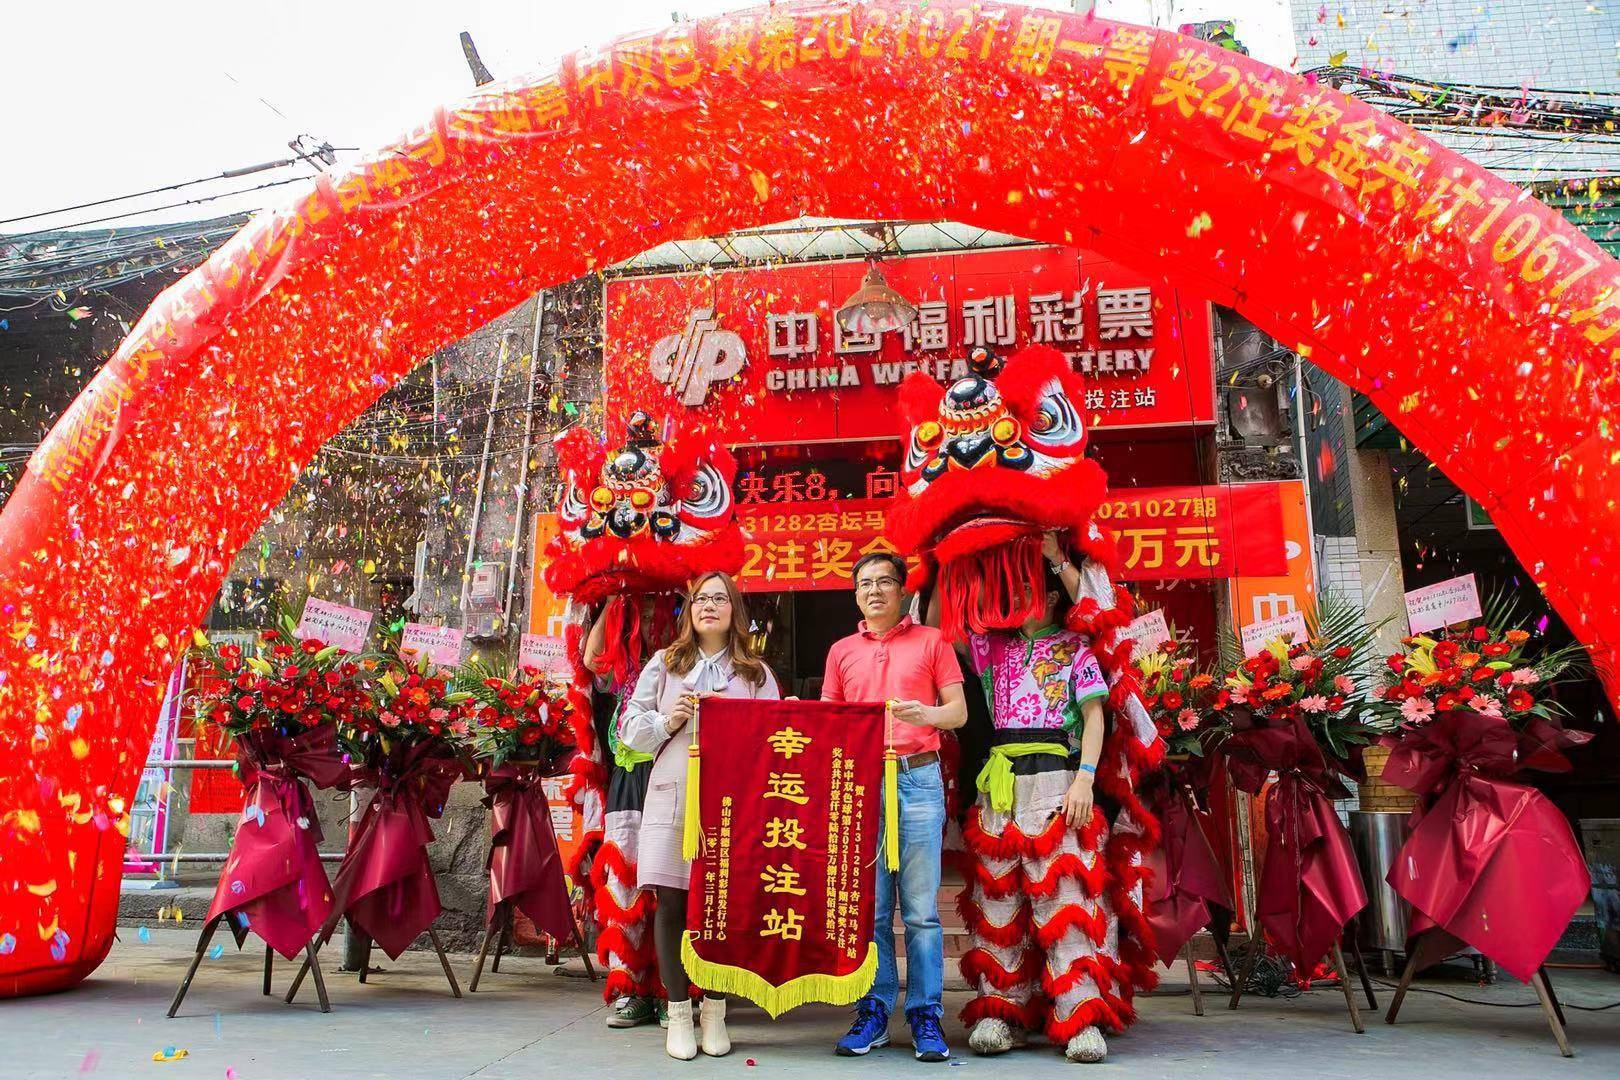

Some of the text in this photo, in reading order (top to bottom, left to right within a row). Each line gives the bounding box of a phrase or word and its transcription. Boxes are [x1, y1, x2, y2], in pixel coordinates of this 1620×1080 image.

[766, 287, 1154, 359] 中国福利彩票
[766, 364, 861, 392] CHINA
[1085, 387, 1156, 410] 投注站
[1091, 496, 1217, 520] 021027期
[1112, 526, 1221, 570] 万元
[759, 726, 812, 942] 幸运投注站
[703, 826, 718, 941] 二零二一年三月十七日
[846, 785, 866, 960] 贺44131282杏坛马齐站
